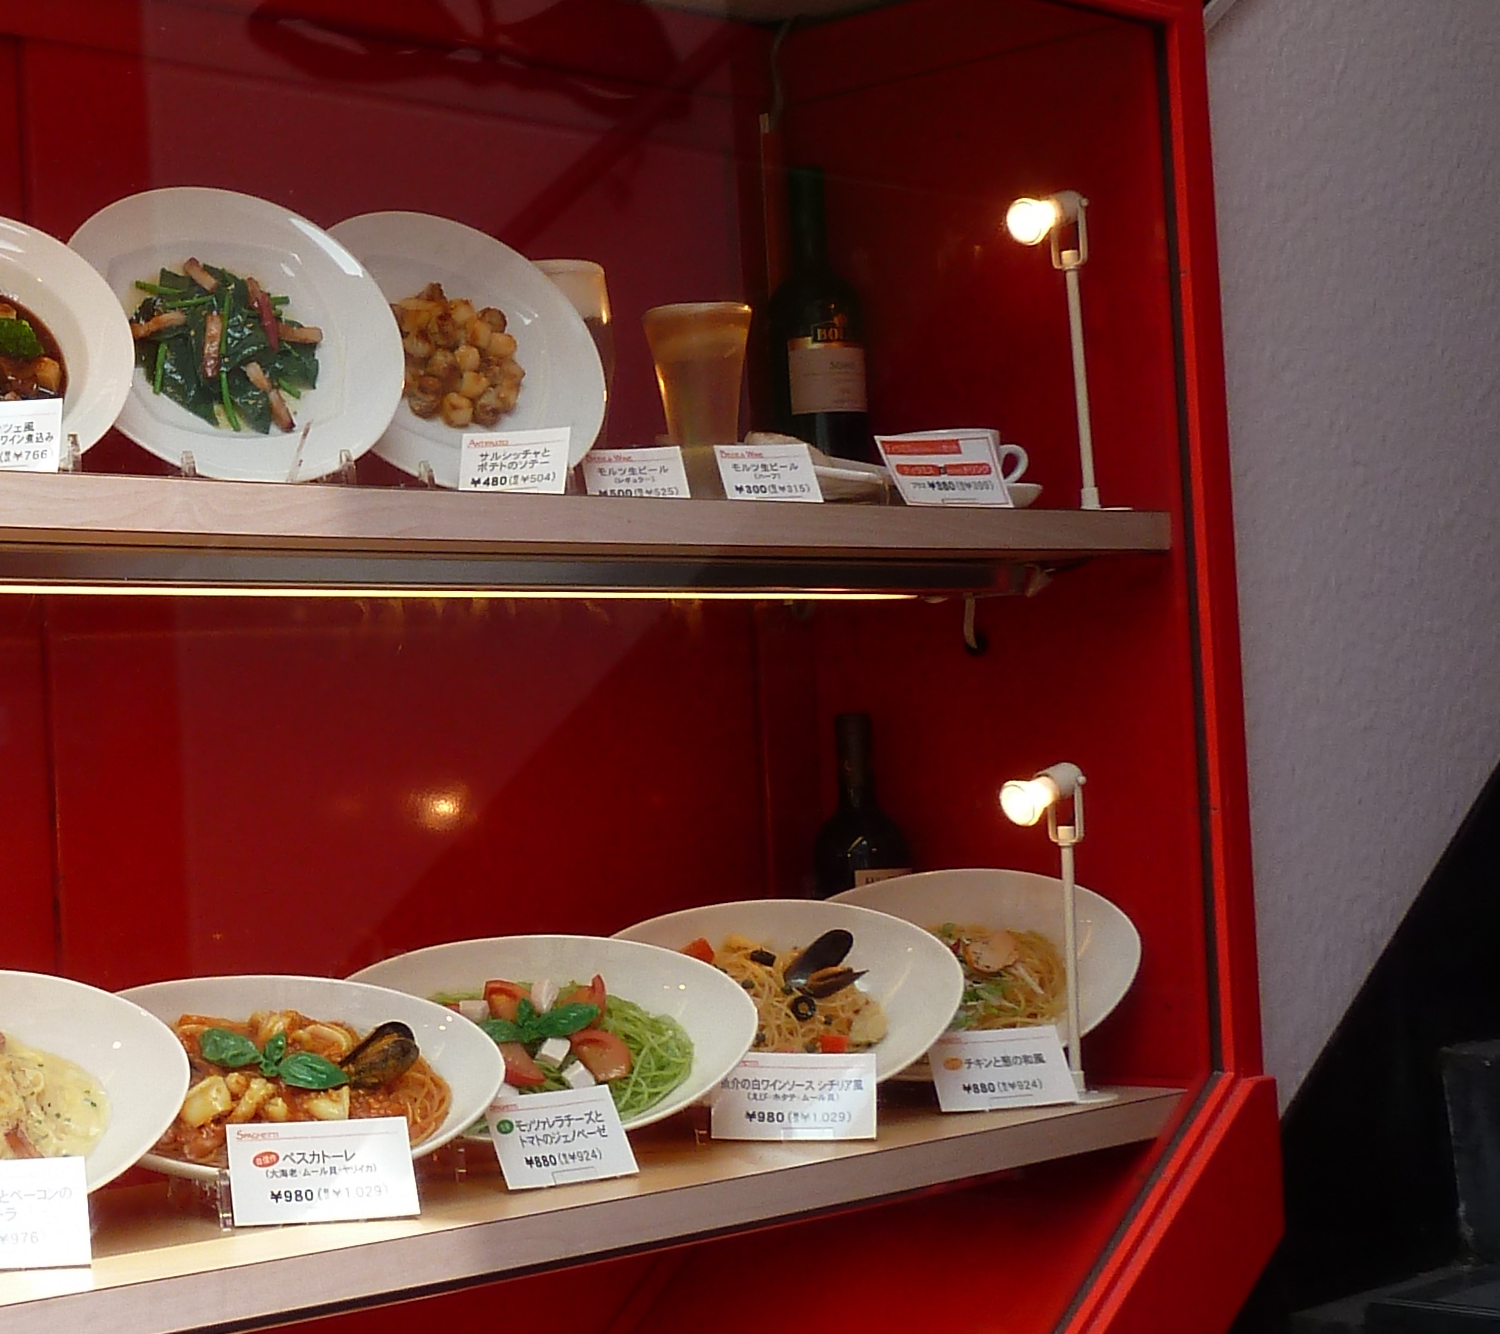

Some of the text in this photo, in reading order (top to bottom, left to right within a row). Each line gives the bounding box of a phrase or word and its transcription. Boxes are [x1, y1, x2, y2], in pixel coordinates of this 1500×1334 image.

[597, 465, 669, 477] モルツ生ビール
[731, 462, 799, 473] モルツ生ビール
[470, 476, 508, 488] ¥480
[962, 1082, 996, 1094] ¥880
[745, 1110, 785, 1123] ¥980
[282, 1149, 356, 1166] ペスカトーレ
[524, 1154, 557, 1169] ¥880
[270, 1189, 314, 1204] ¥980
